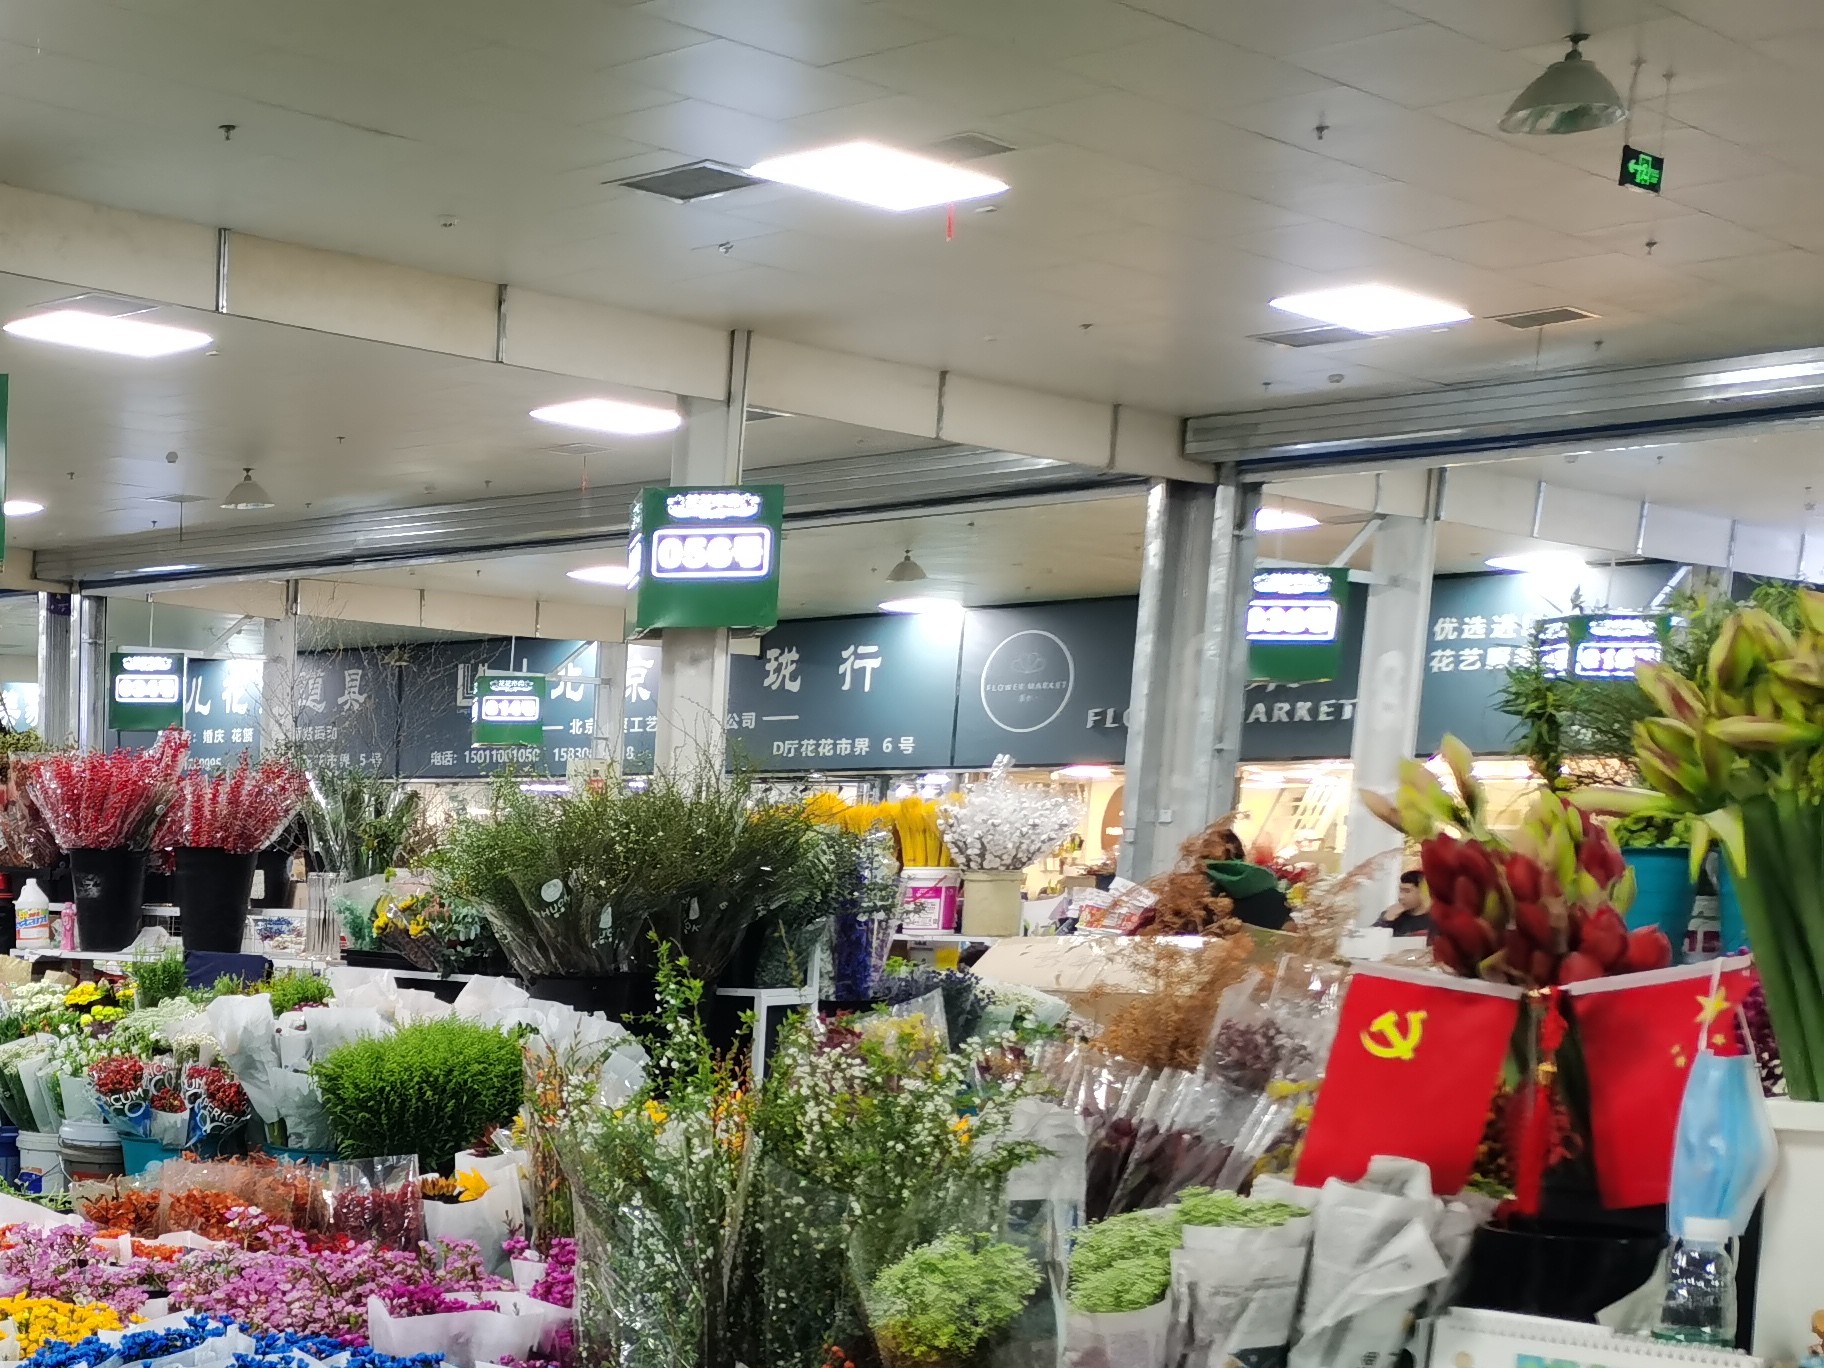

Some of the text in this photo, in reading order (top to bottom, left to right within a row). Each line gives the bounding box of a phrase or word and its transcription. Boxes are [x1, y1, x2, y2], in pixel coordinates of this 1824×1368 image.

[1245, 698, 1359, 724] ARKET
[773, 737, 870, 757] D厅花花市界
